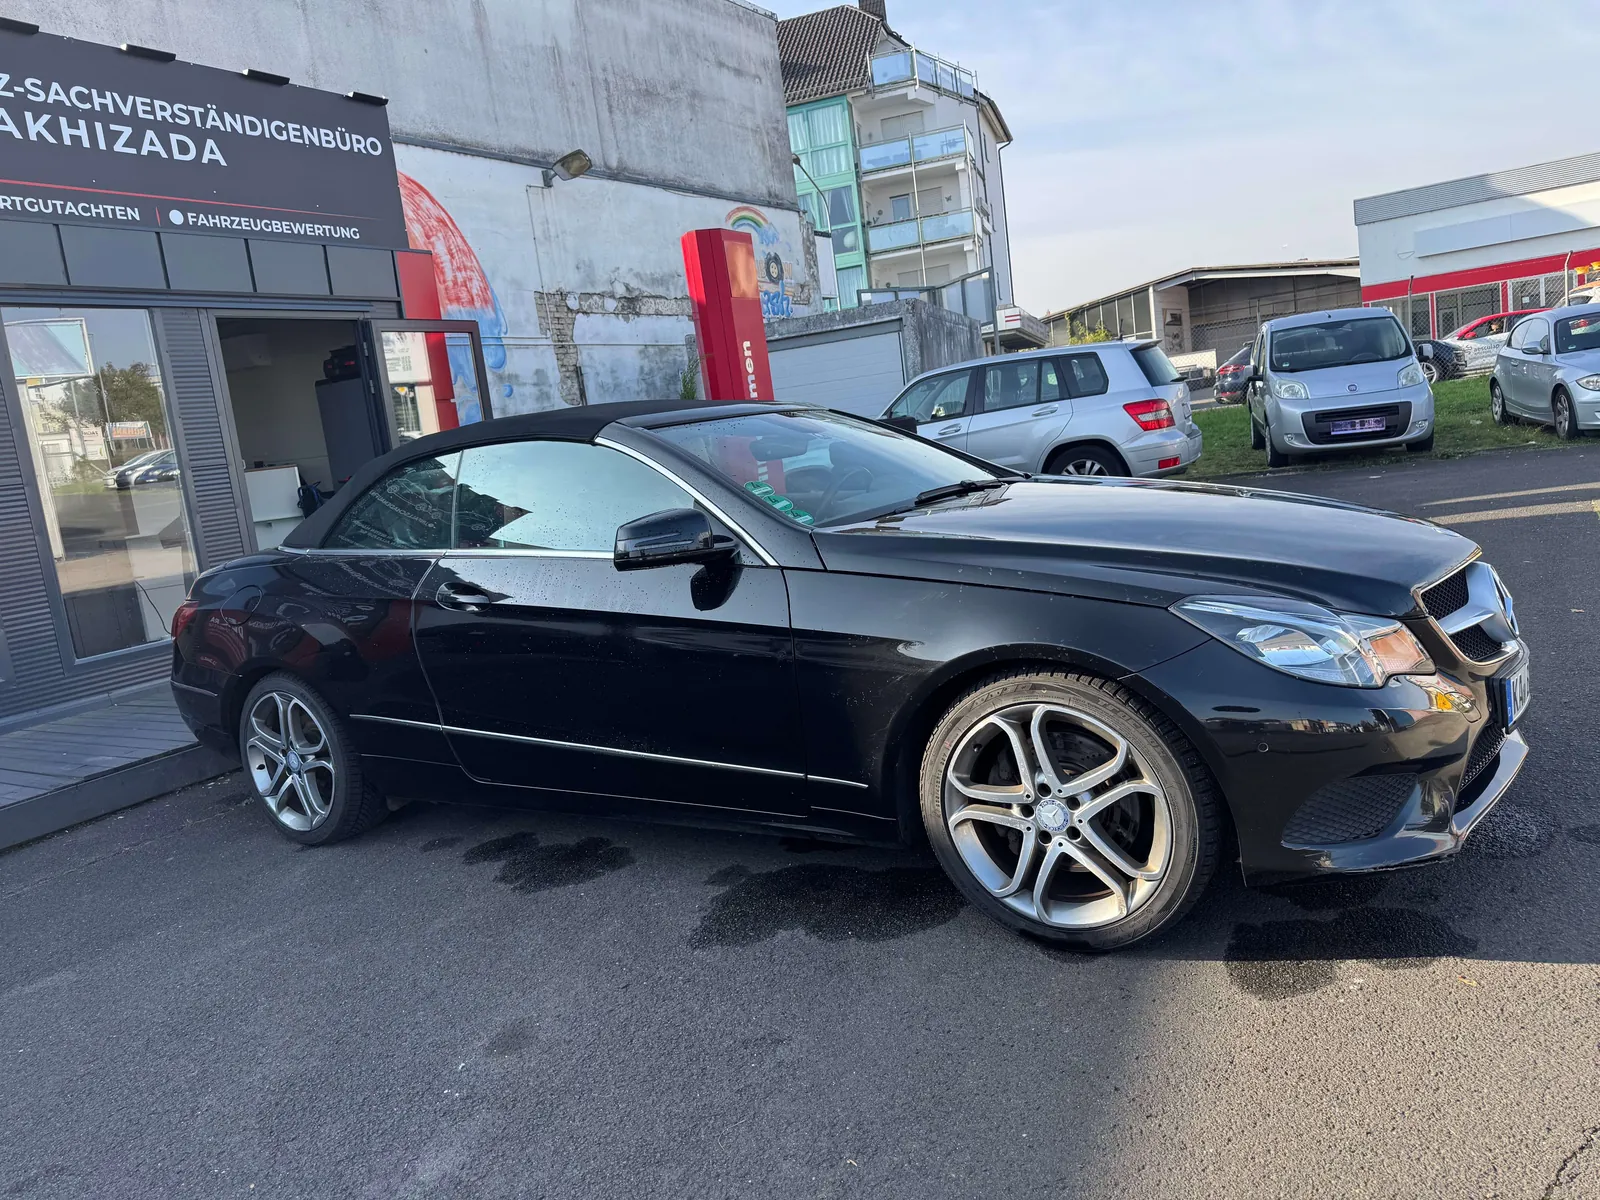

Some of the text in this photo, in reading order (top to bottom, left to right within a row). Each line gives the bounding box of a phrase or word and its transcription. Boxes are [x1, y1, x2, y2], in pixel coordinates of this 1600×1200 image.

[188, 212, 360, 240] FAHRZEUGBEWERTUNG
[742, 340, 759, 401] men
[768, 496, 780, 504] 4
